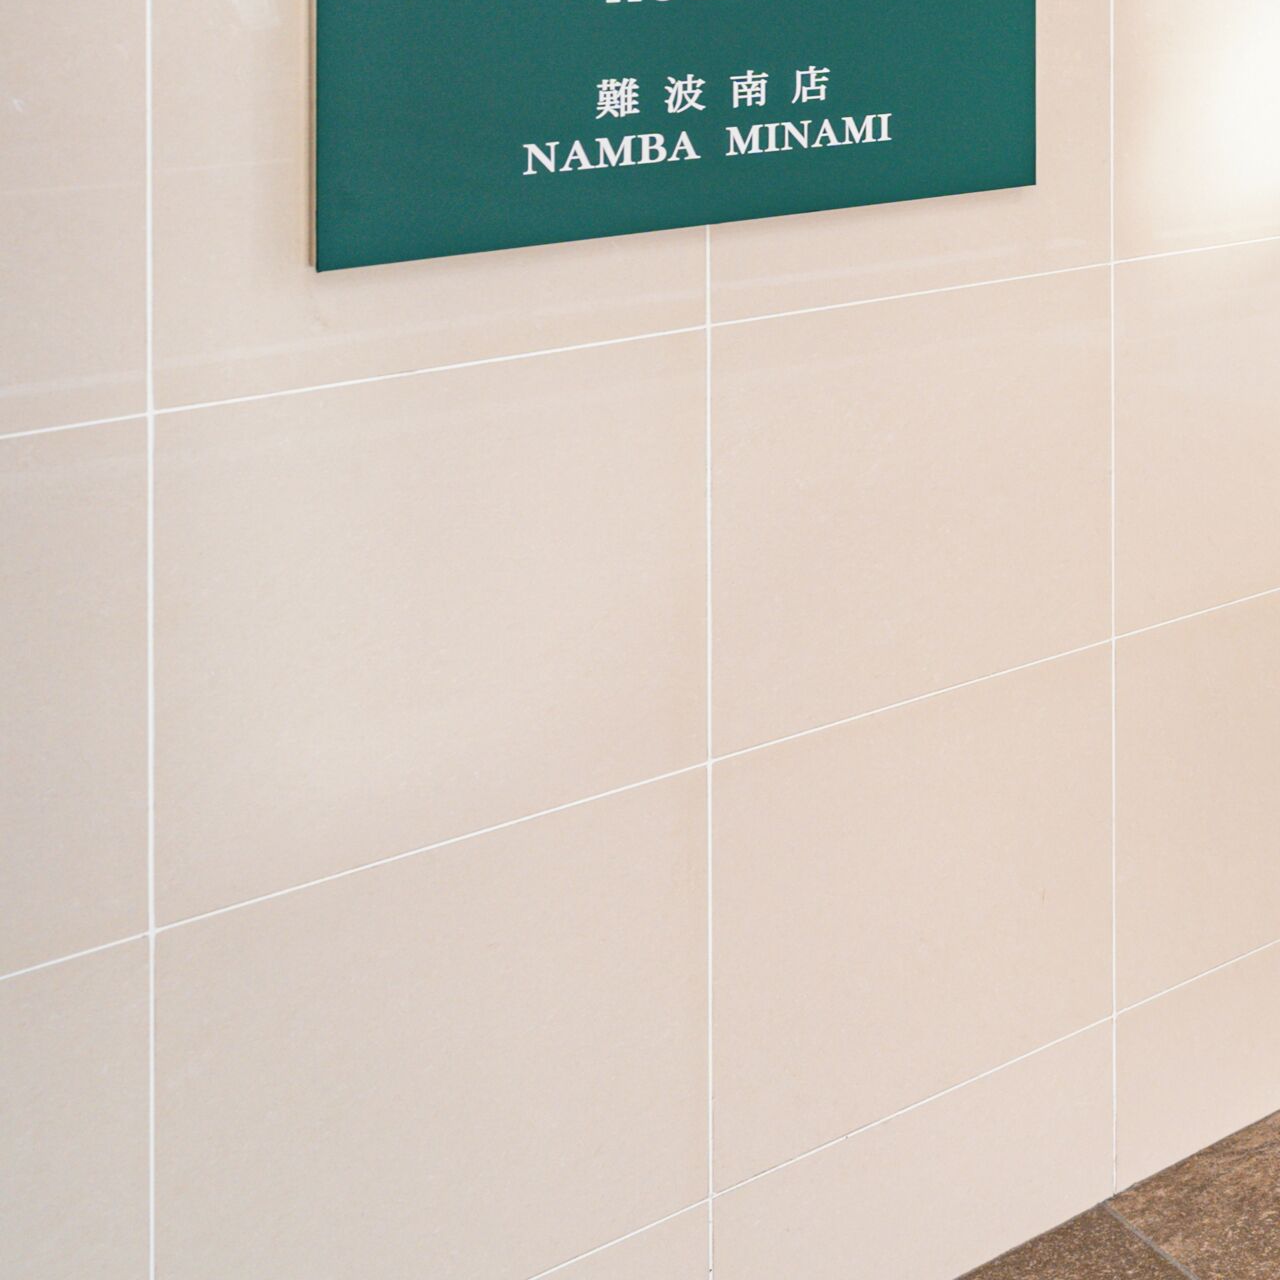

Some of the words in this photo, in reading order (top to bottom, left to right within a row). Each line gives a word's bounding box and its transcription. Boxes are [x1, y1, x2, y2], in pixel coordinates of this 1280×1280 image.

[595, 65, 831, 119] 難波南店
[522, 130, 702, 176] NAMBA
[725, 112, 893, 157] MINAMI
